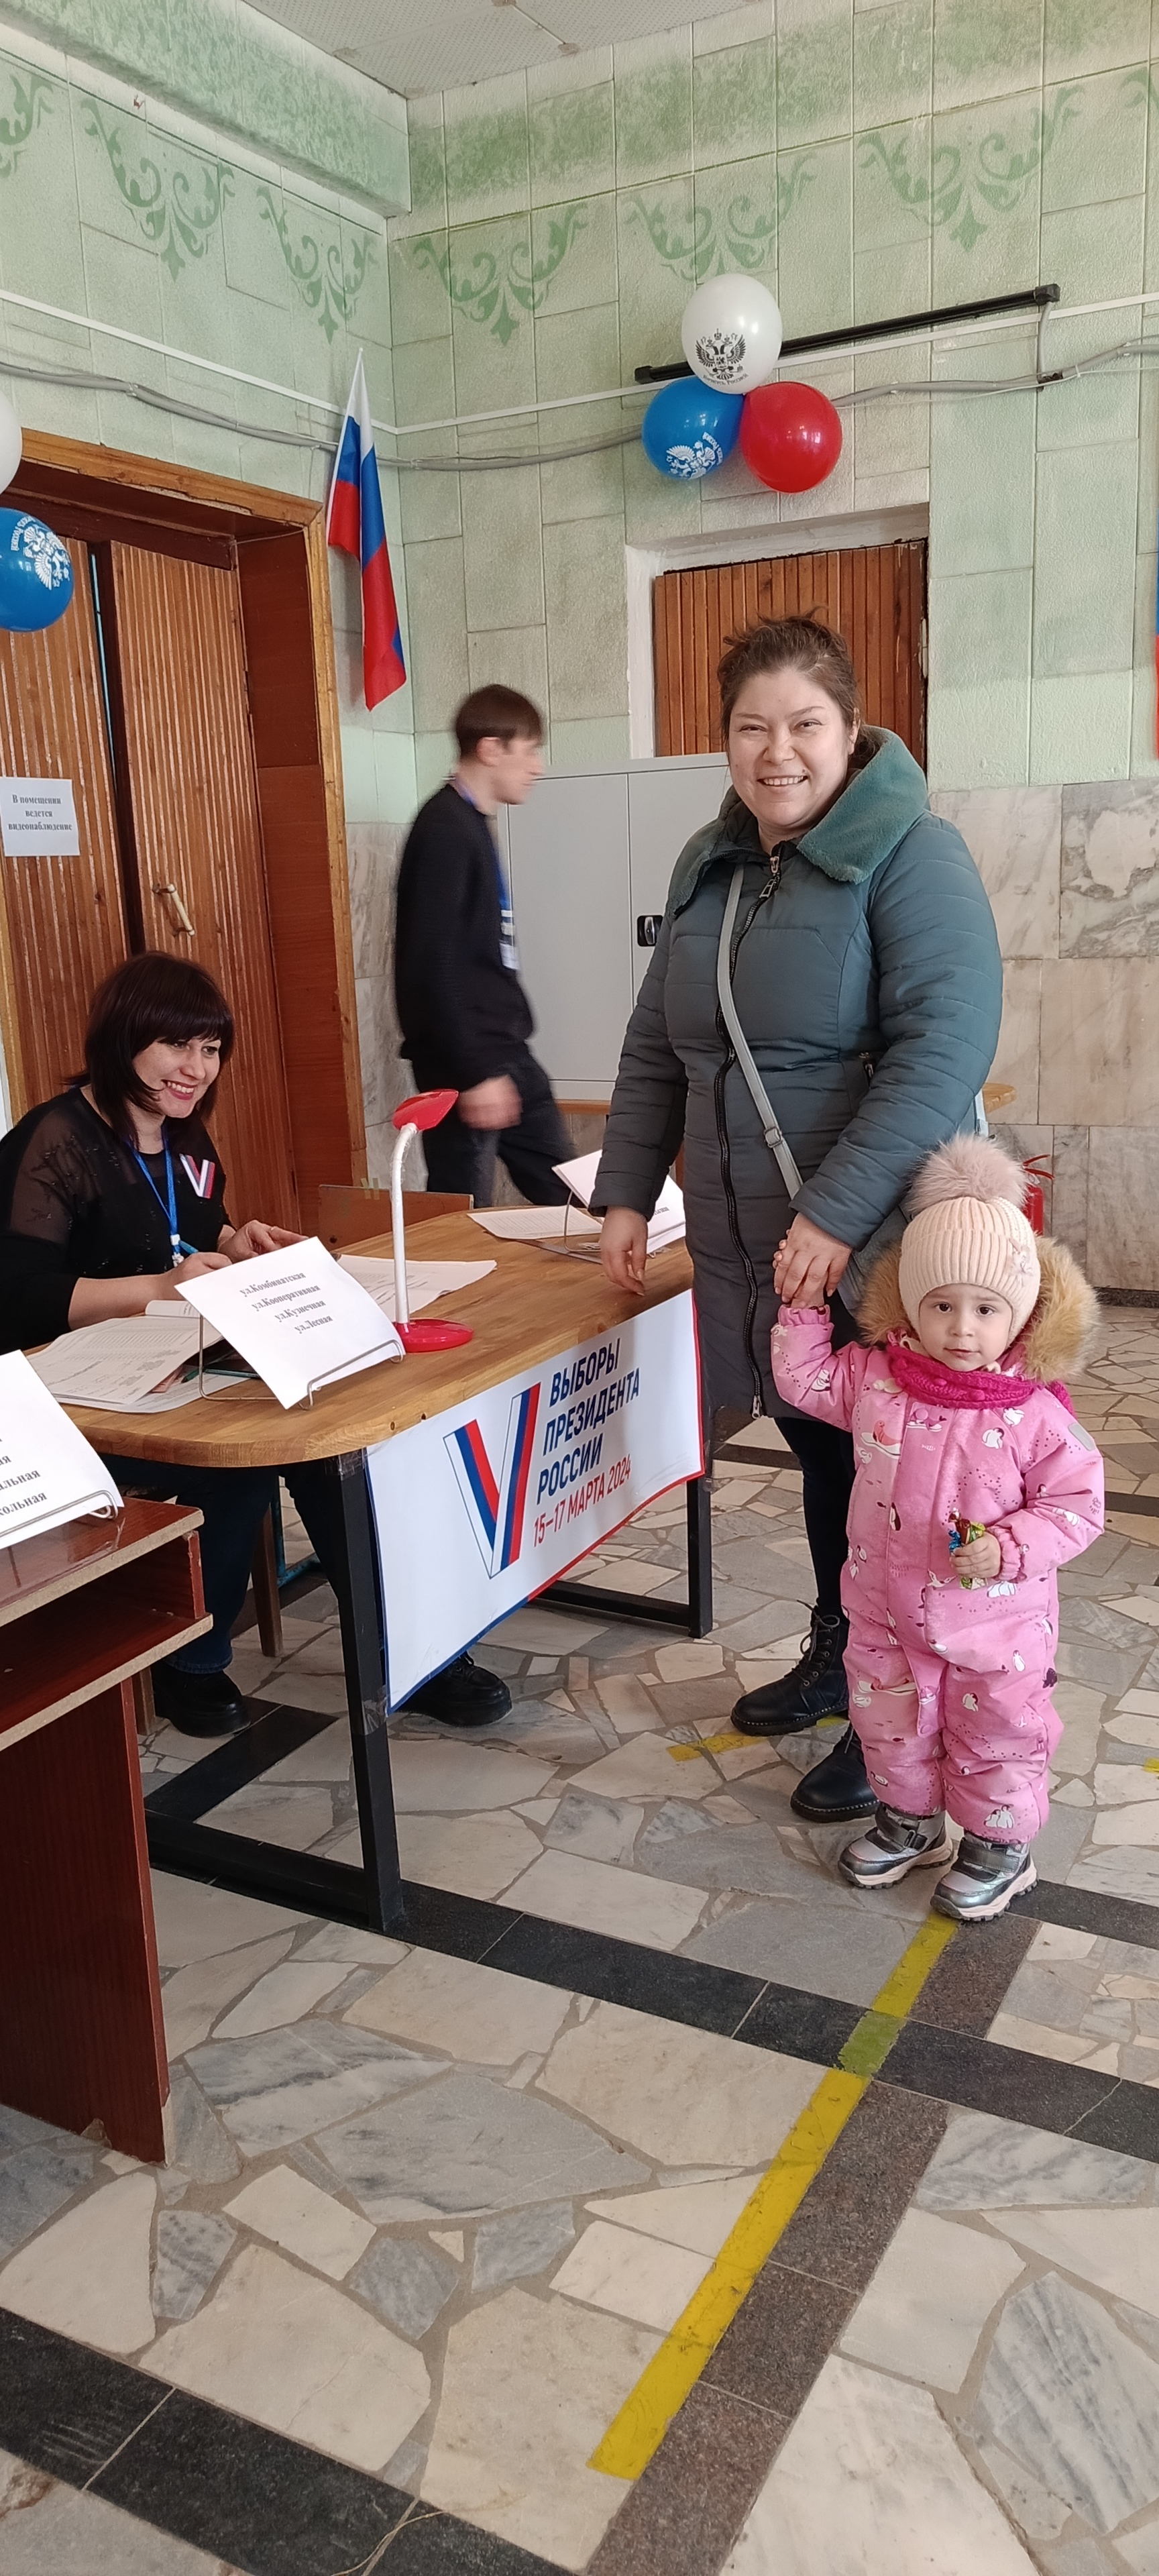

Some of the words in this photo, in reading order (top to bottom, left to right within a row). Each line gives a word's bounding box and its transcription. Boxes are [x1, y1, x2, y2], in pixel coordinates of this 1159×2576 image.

[12, 794, 18, 804] В
[20, 796, 62, 805] помещении
[8, 822, 72, 831] видеонаблюдение
[239, 1273, 307, 1297] ул.Комбинатская
[252, 1285, 321, 1311] ул.Кооперативная
[274, 1301, 326, 1322] ул.Кузнечная
[294, 1316, 333, 1334] ул.Лесная
[549, 1338, 621, 1407] ВЫБОРЫ
[543, 1367, 640, 1456] ПРЕЗИДЕНТА
[537, 1432, 604, 1505] РОССИИ
[567, 1472, 604, 1523] МАРТА
[607, 1454, 631, 1495] 2024
